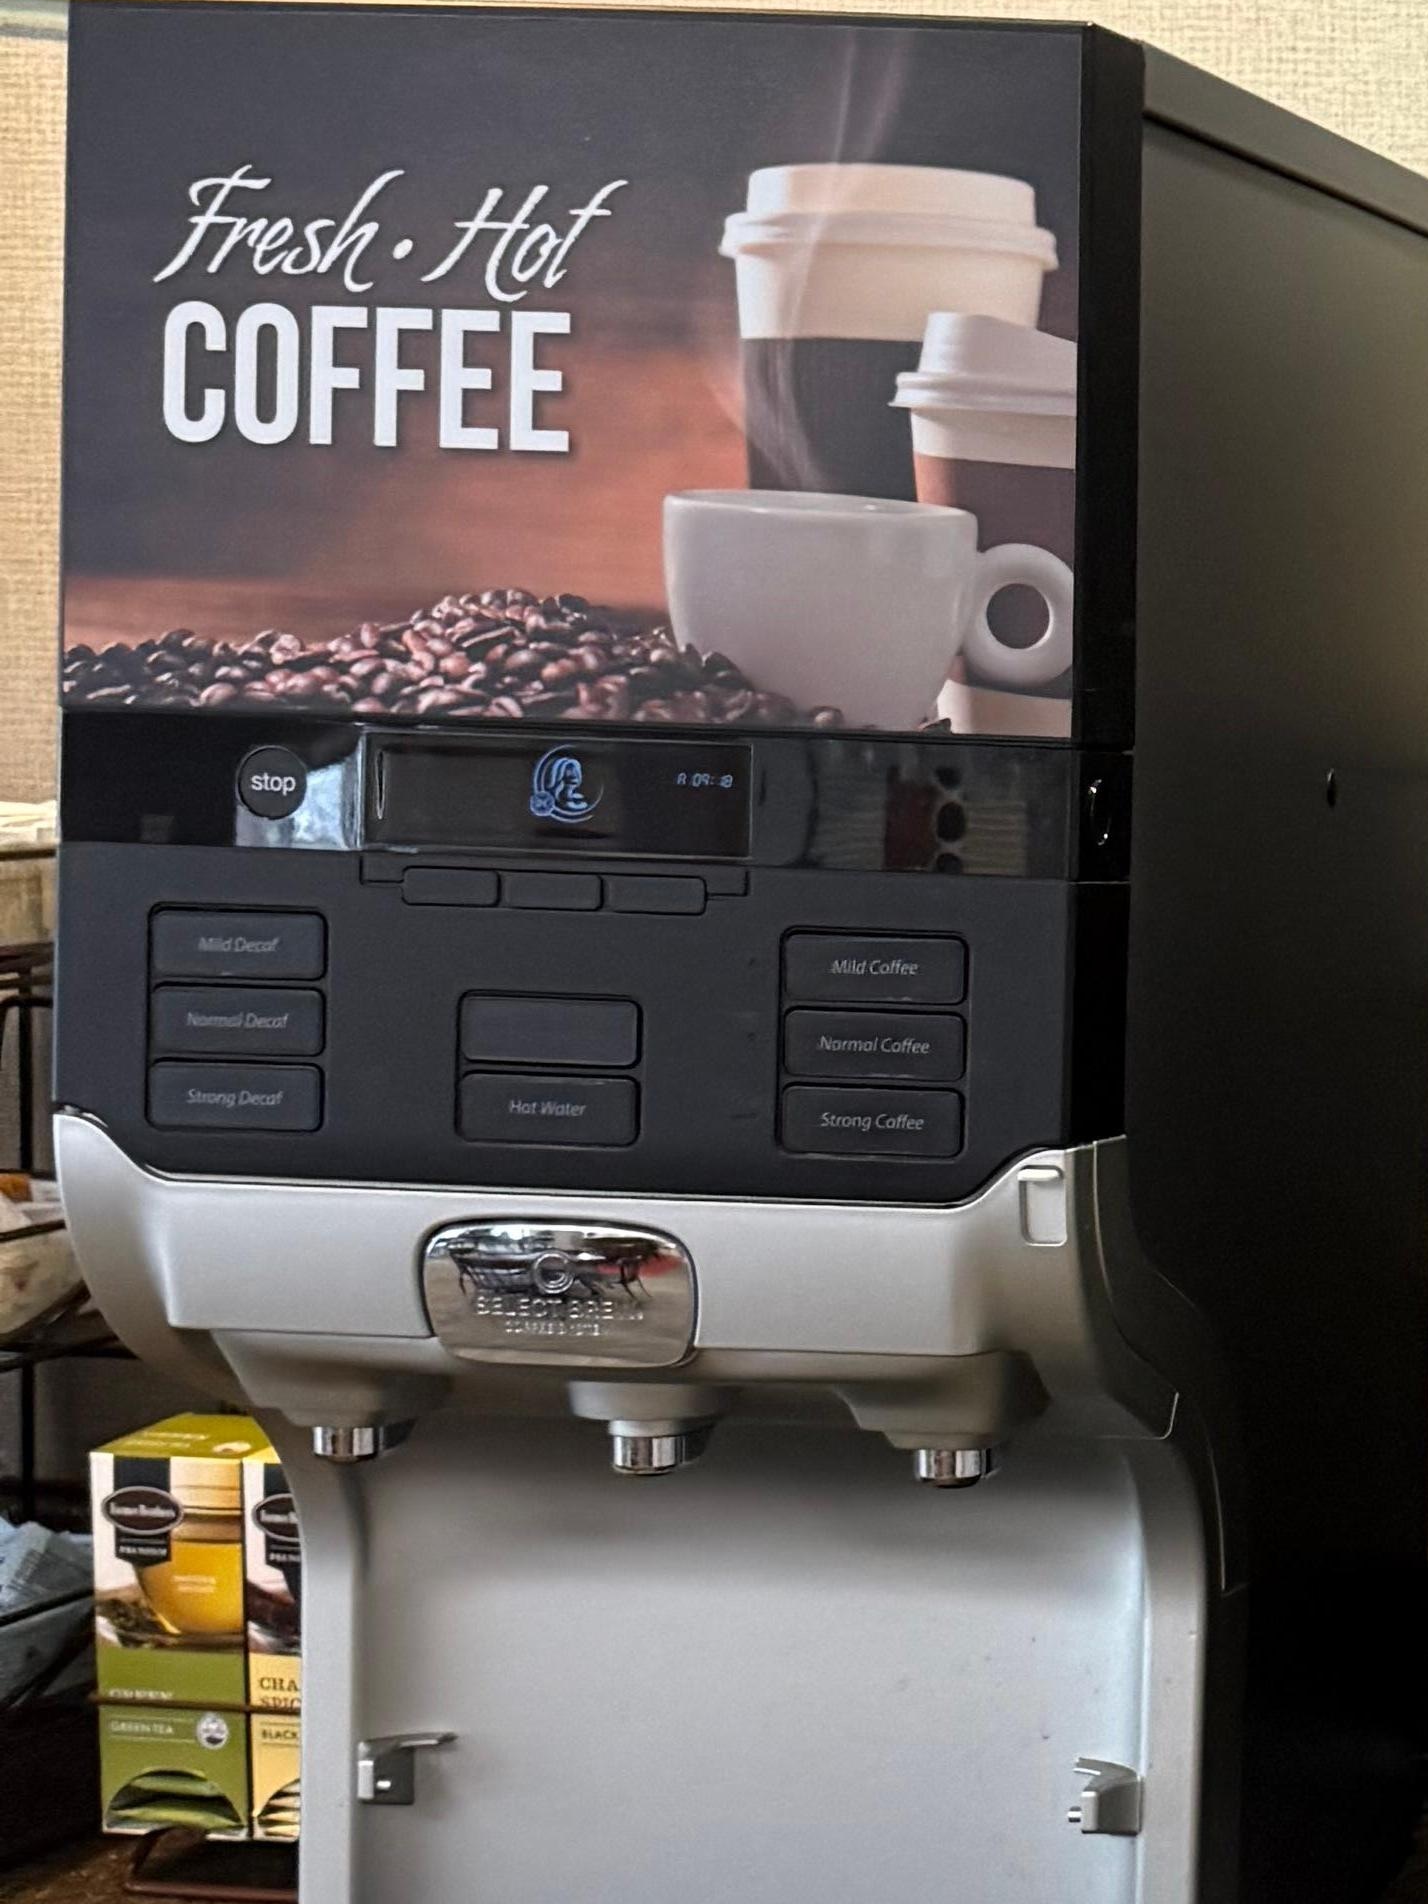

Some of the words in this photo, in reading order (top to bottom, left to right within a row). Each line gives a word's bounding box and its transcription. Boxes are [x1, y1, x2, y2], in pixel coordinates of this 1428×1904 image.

[153, 164, 404, 292] Fresh
[420, 179, 628, 302] Hot
[163, 300, 571, 452] COFFEE
[251, 772, 297, 796] stop
[234, 937, 279, 953] Decaf
[832, 960, 867, 975] Mild
[869, 960, 918, 975] Coffee
[244, 1013, 289, 1029] Decaf
[819, 1036, 878, 1052] Normal
[880, 1038, 930, 1054] Coffee
[187, 1089, 237, 1107] Strong
[238, 1090, 284, 1105] Decaf
[509, 1100, 537, 1114] Hot
[540, 1101, 587, 1116] Water
[820, 1112, 872, 1131] Strong
[875, 1114, 925, 1130] Coffee
